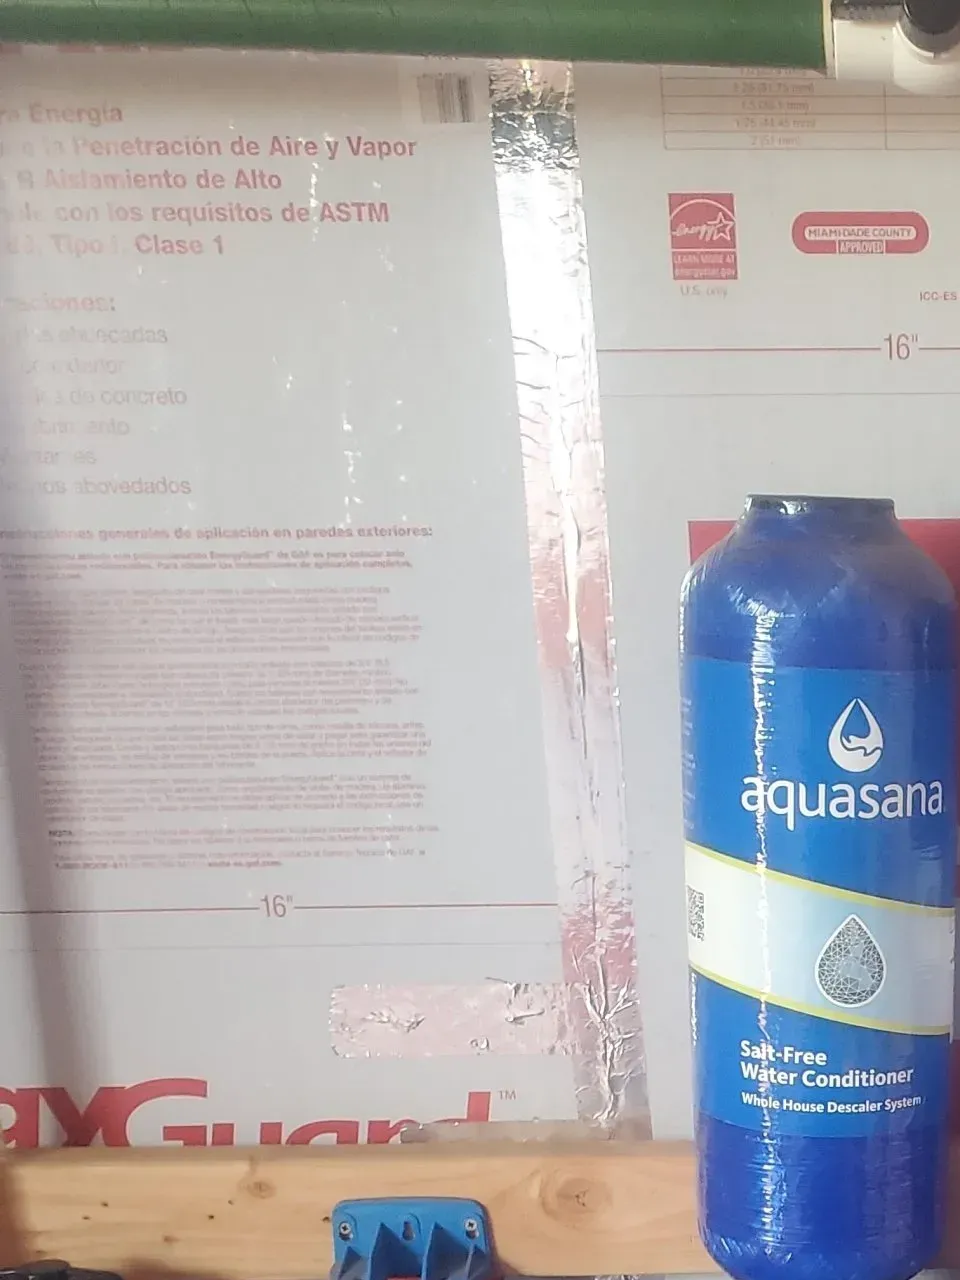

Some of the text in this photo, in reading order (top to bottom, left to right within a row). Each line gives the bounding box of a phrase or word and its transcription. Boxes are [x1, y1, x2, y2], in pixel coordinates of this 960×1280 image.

[73, 135, 417, 160] Penetración de Aire y Vapor
[196, 168, 225, 189] de
[235, 168, 282, 189] Alto
[152, 200, 272, 226] requisitos
[281, 202, 309, 222] de
[319, 202, 389, 222] ASTM
[134, 233, 203, 254] Clase
[213, 234, 223, 254] 1
[872, 228, 912, 238] COUNTY
[839, 241, 884, 253] APPROVED
[883, 333, 919, 361] 16"
[357, 524, 433, 538] exteriores:
[740, 776, 943, 831] aquasana
[260, 894, 293, 918] 16"
[740, 1040, 827, 1066] Salt-Free
[740, 1061, 914, 1088] Water Conditioner
[741, 1092, 922, 1113] Whole House Descaler System
